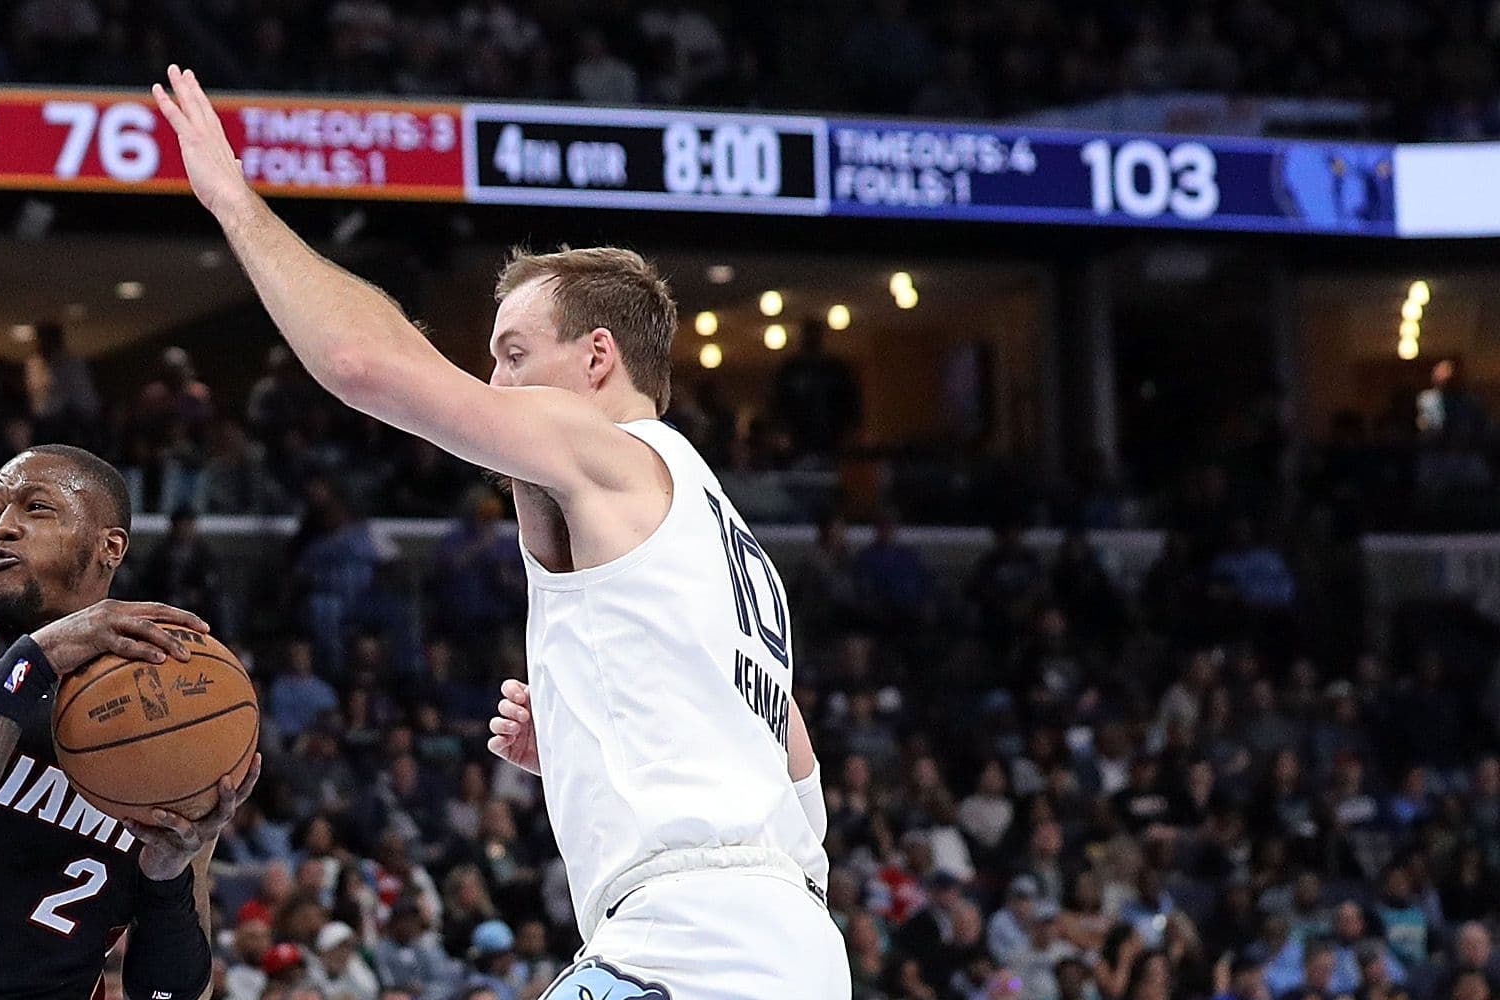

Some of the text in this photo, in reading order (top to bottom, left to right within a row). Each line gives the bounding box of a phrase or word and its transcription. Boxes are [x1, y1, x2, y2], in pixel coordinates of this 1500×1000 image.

[42, 100, 160, 182] 76
[663, 121, 781, 197] 8:00
[1082, 139, 1220, 220] 103
[703, 485, 789, 669] 10
[734, 648, 789, 754] KENNAR
[30, 857, 108, 935] 2
